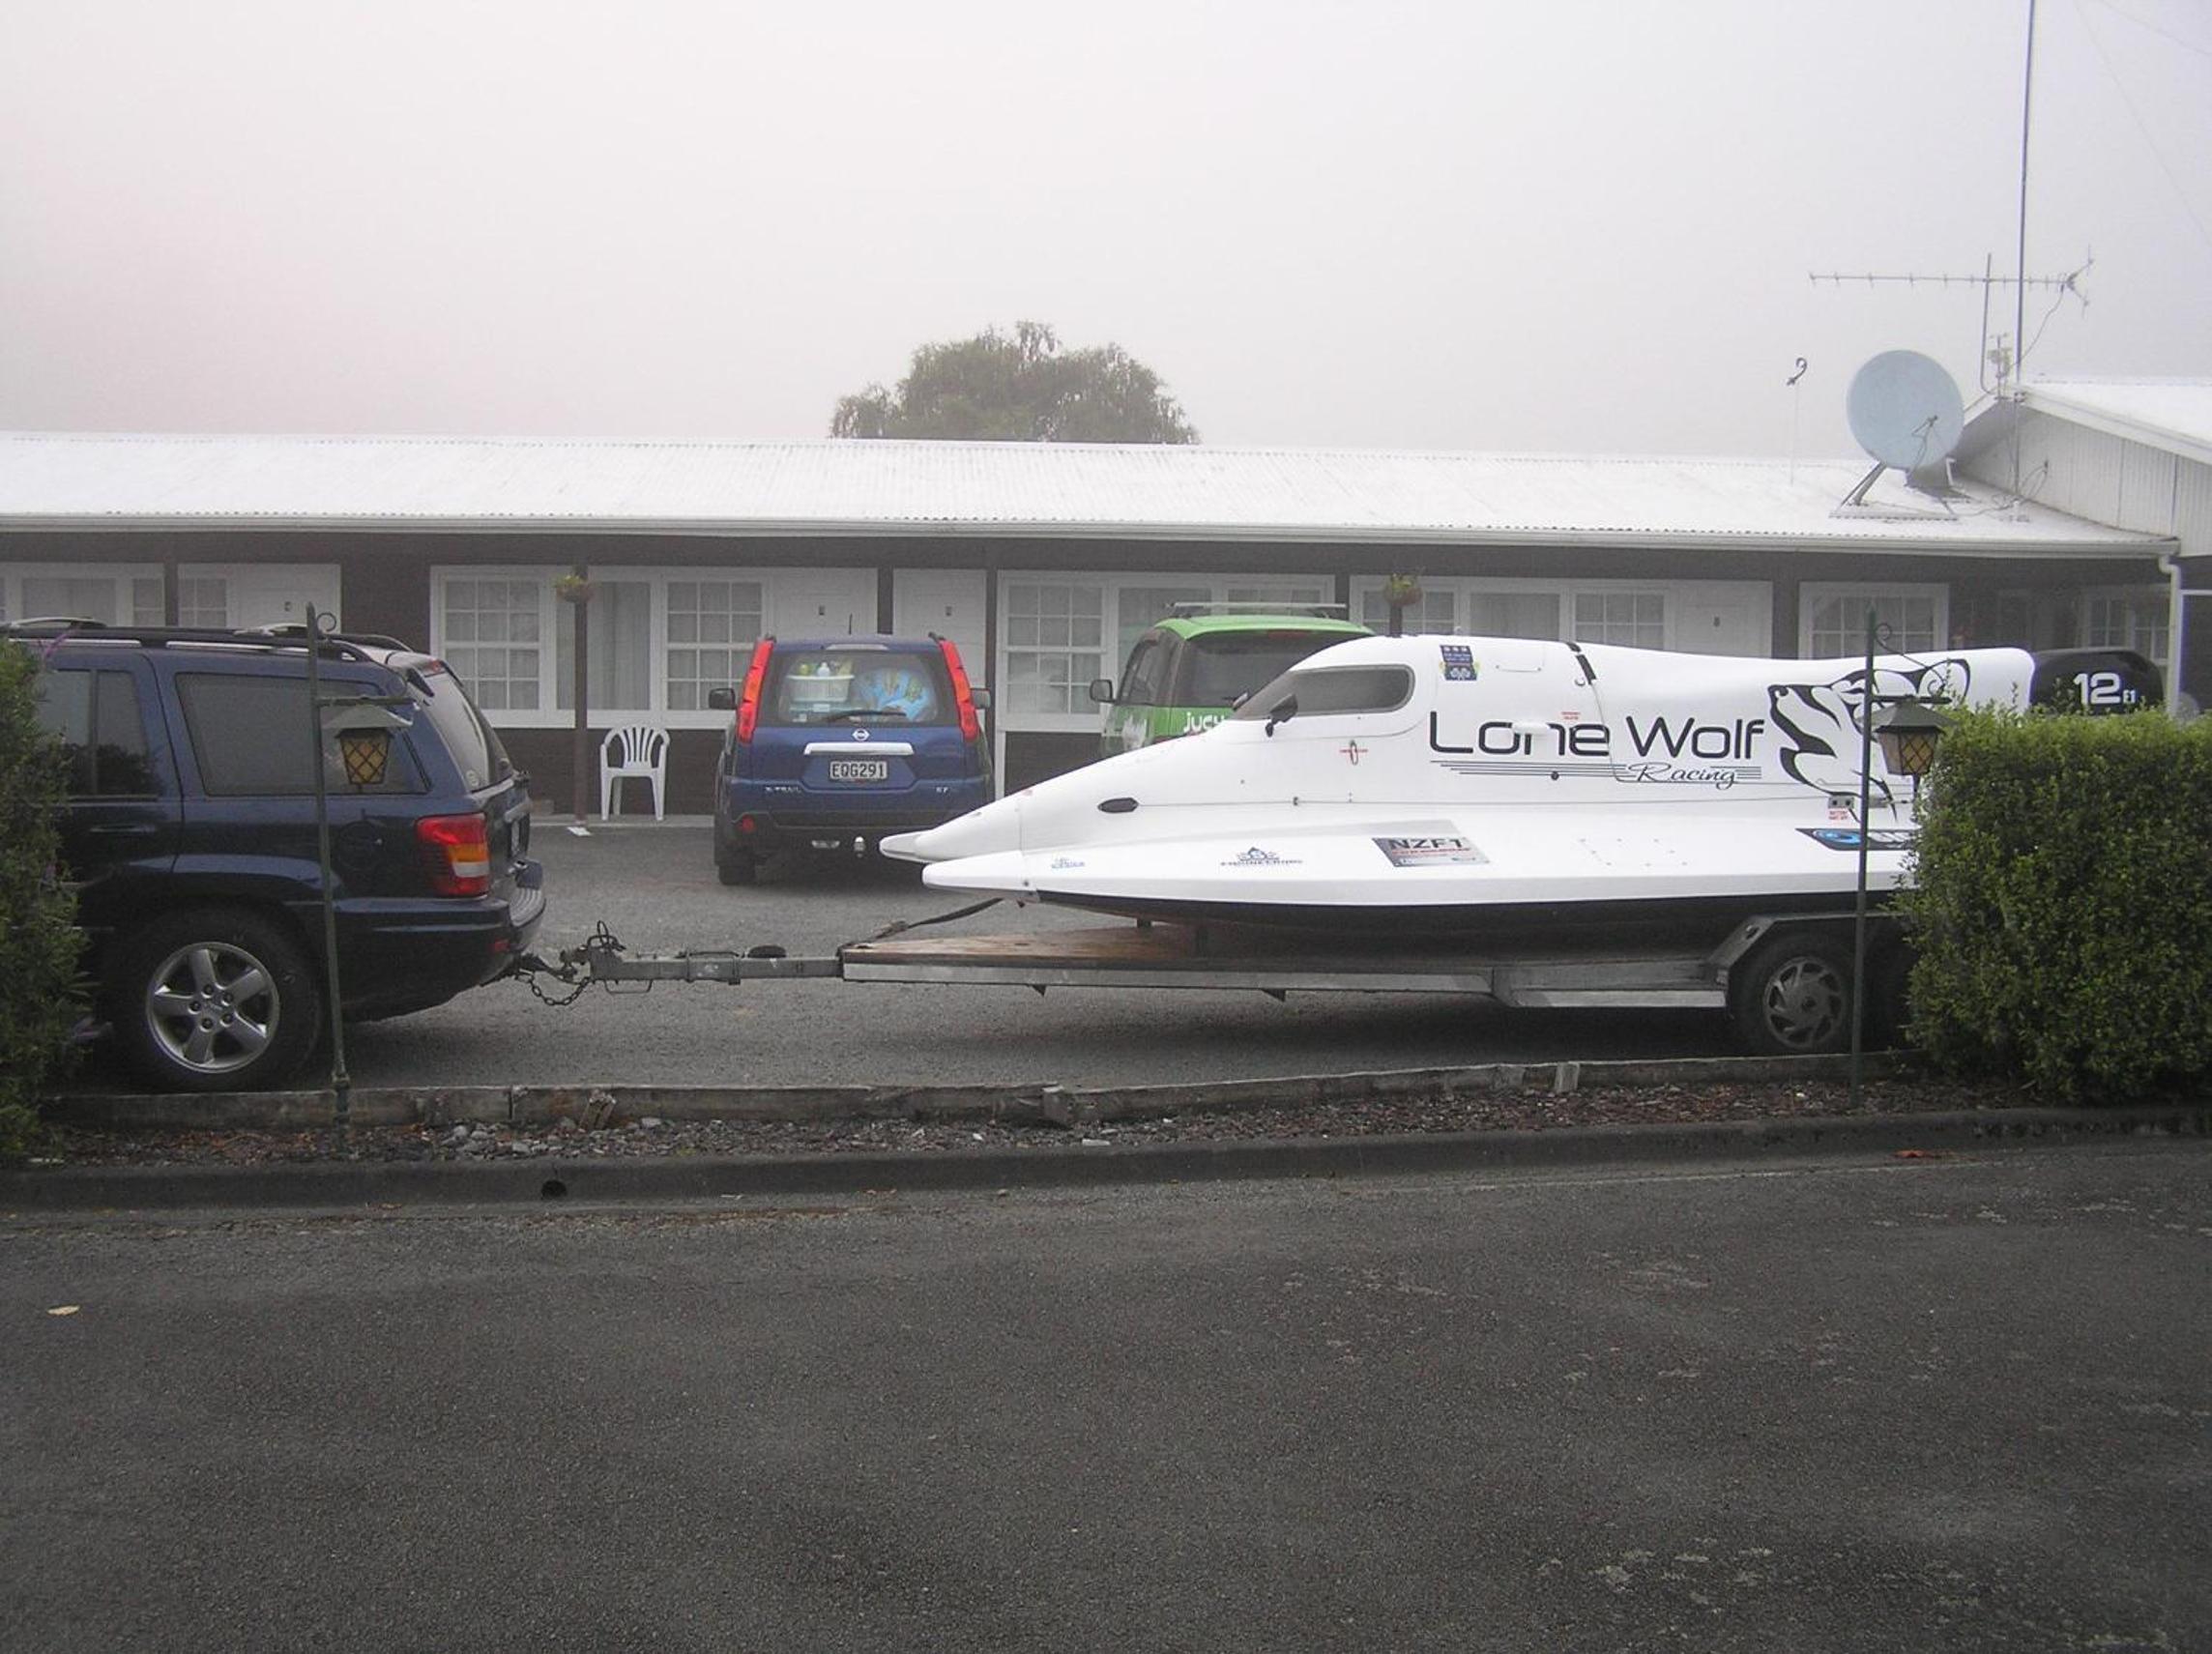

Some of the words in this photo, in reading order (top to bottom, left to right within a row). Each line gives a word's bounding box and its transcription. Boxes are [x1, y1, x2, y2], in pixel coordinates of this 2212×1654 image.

[2073, 672, 2121, 704] 12
[1429, 711, 1610, 756] Lone
[1625, 715, 1765, 759] Wolf
[831, 763, 884, 777] EQG291
[1627, 762, 1737, 790] Racing
[1389, 838, 1463, 849] NZF1
